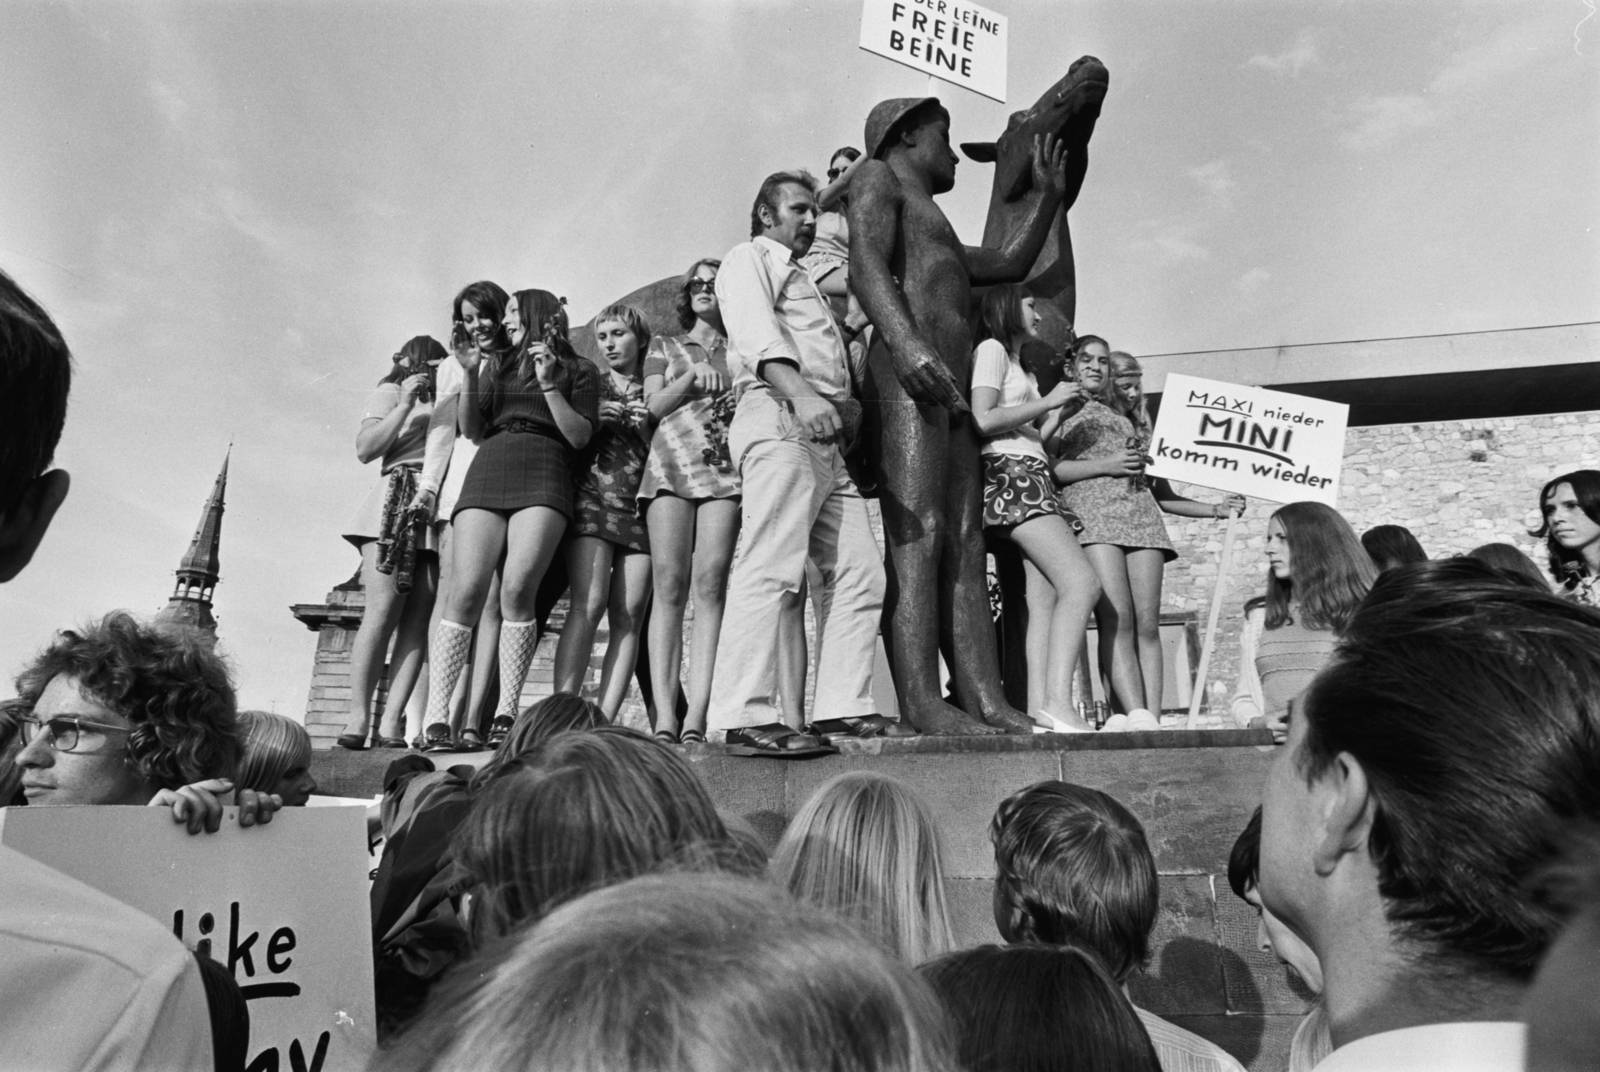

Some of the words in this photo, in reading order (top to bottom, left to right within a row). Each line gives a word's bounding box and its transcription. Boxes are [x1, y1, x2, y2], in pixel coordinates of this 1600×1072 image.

[892, 2, 975, 52] FREIE
[954, 7, 1000, 36] LEINE
[889, 29, 973, 78] BEINE
[1188, 390, 1253, 414] MAXI
[1263, 406, 1324, 428] nieder
[1199, 412, 1293, 453] MINI
[1156, 437, 1239, 471] komm
[1251, 462, 1333, 490] wieder
